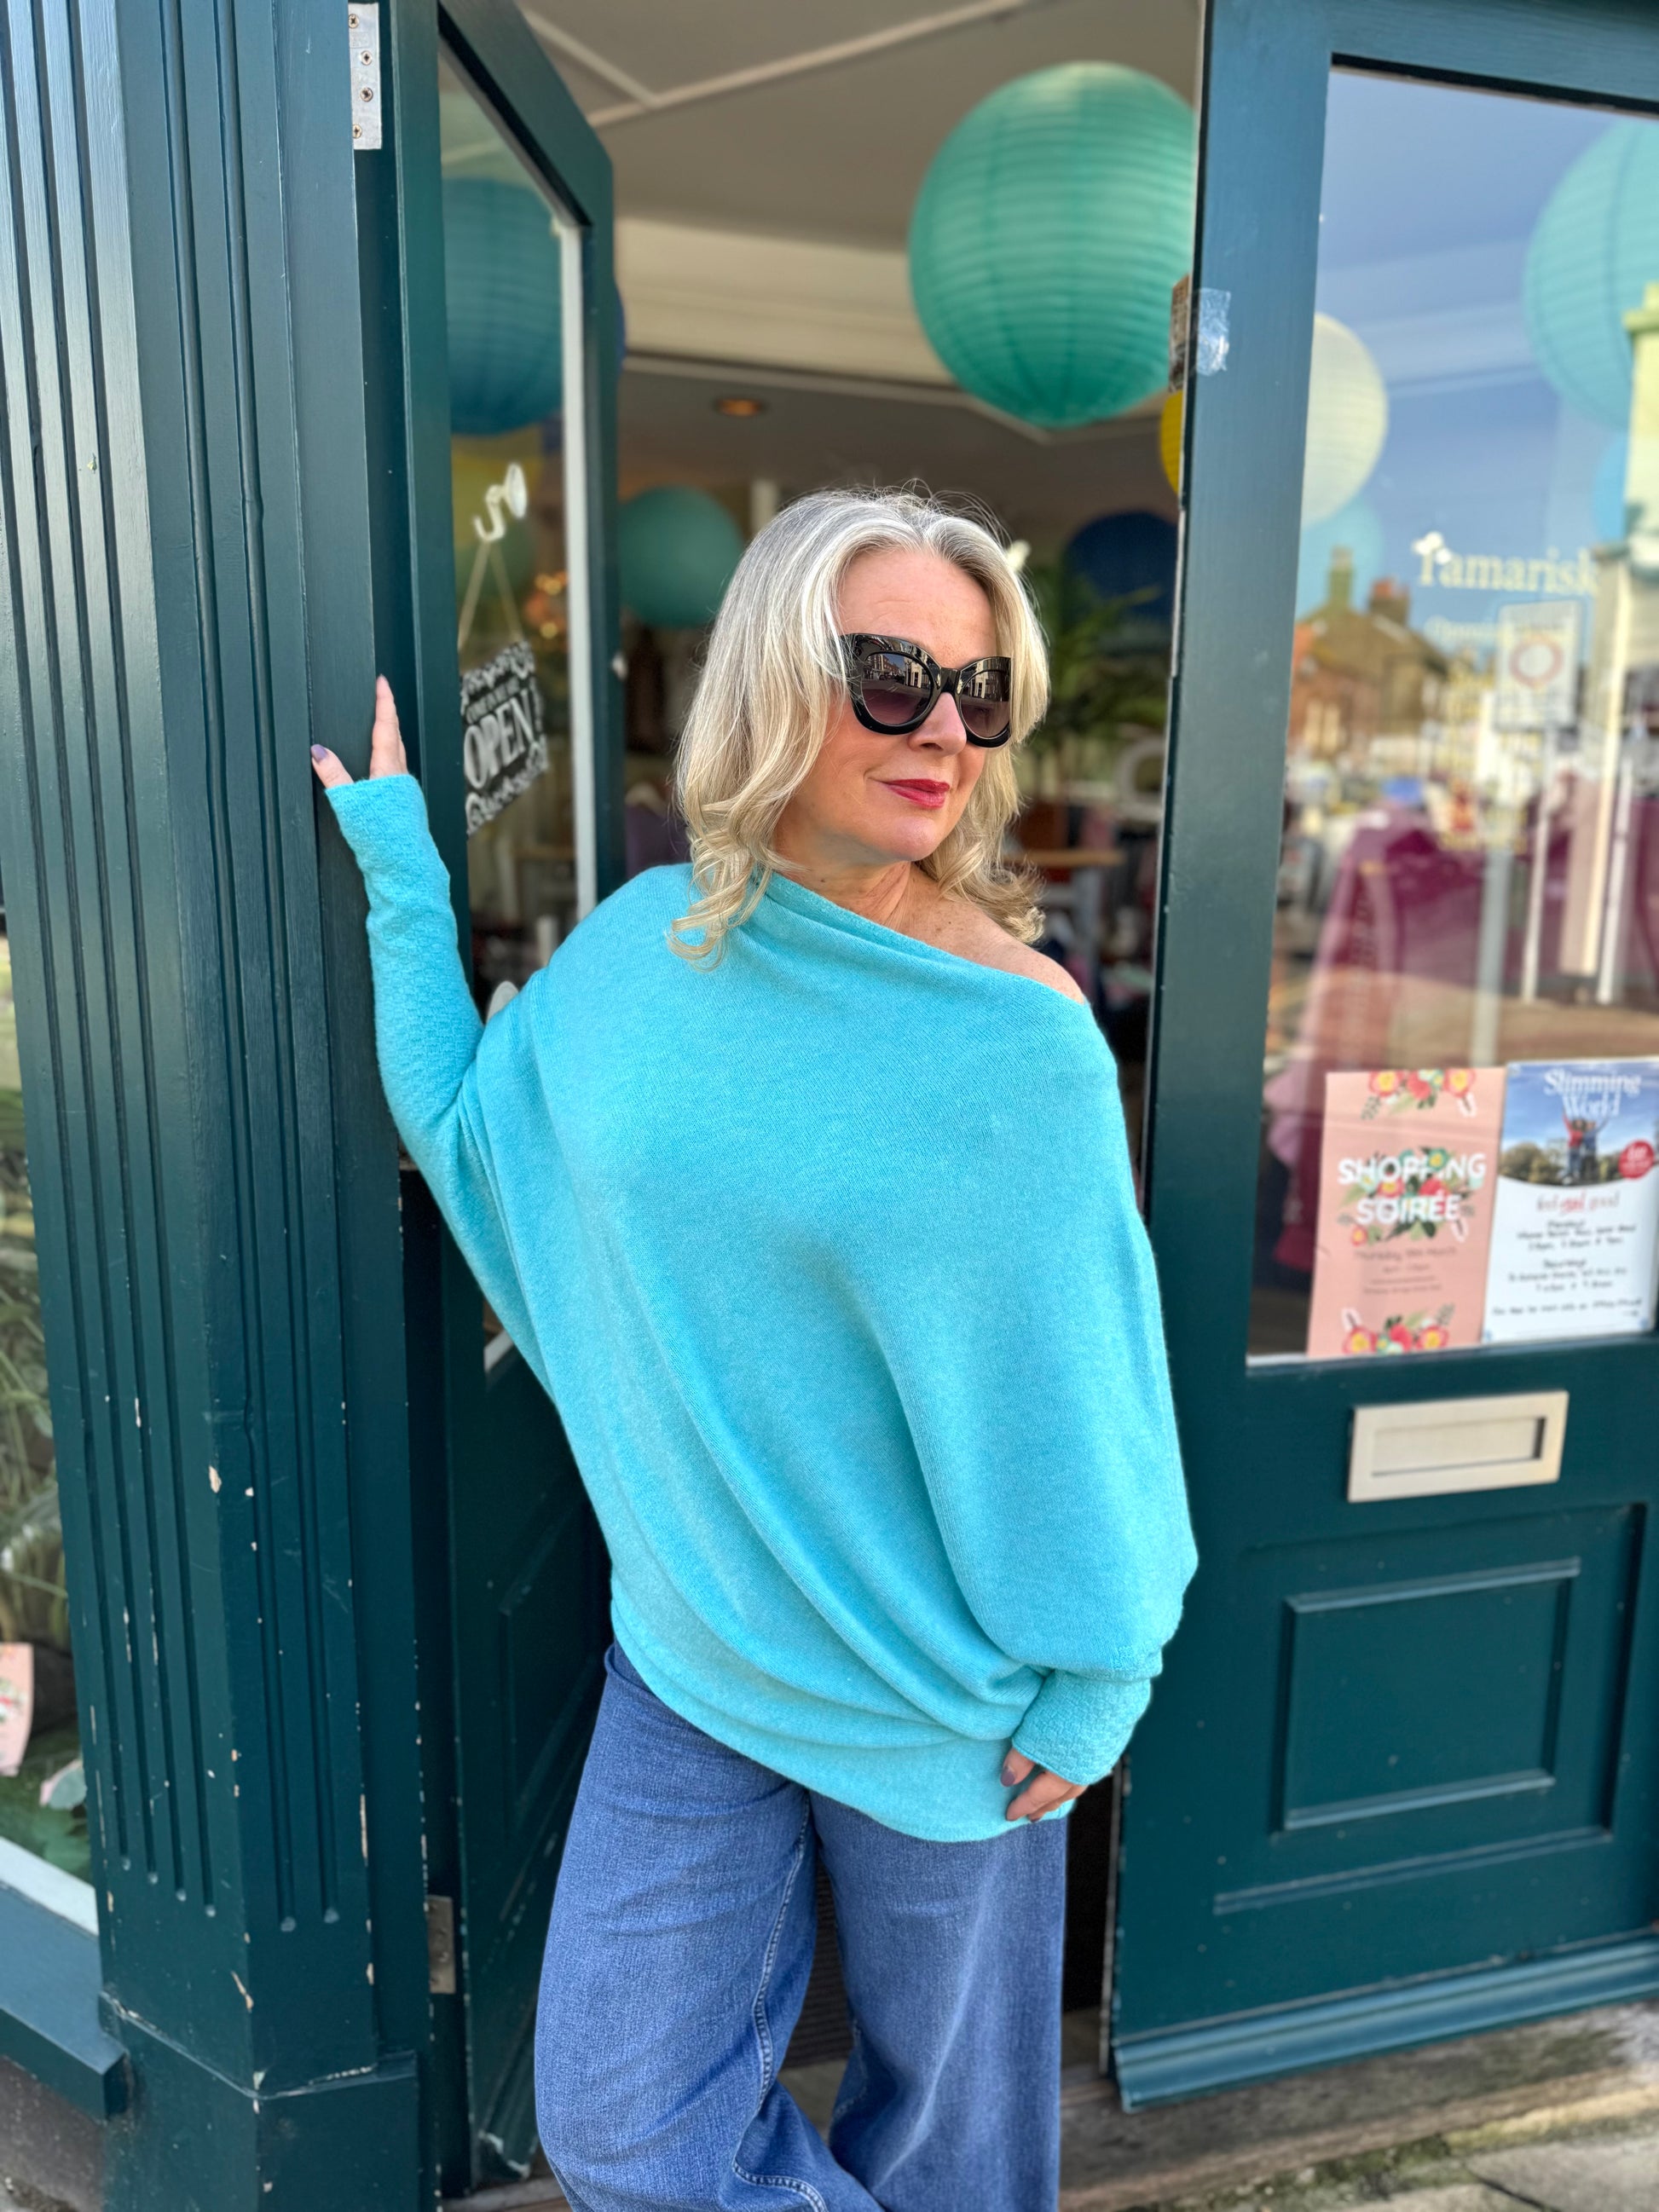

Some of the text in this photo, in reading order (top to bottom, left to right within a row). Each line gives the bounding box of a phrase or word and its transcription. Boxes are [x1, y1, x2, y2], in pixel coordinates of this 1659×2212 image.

[1413, 532, 1598, 595] Tamarisk
[1544, 1069, 1641, 1098] Slimming
[1562, 1092, 1621, 1118] World
